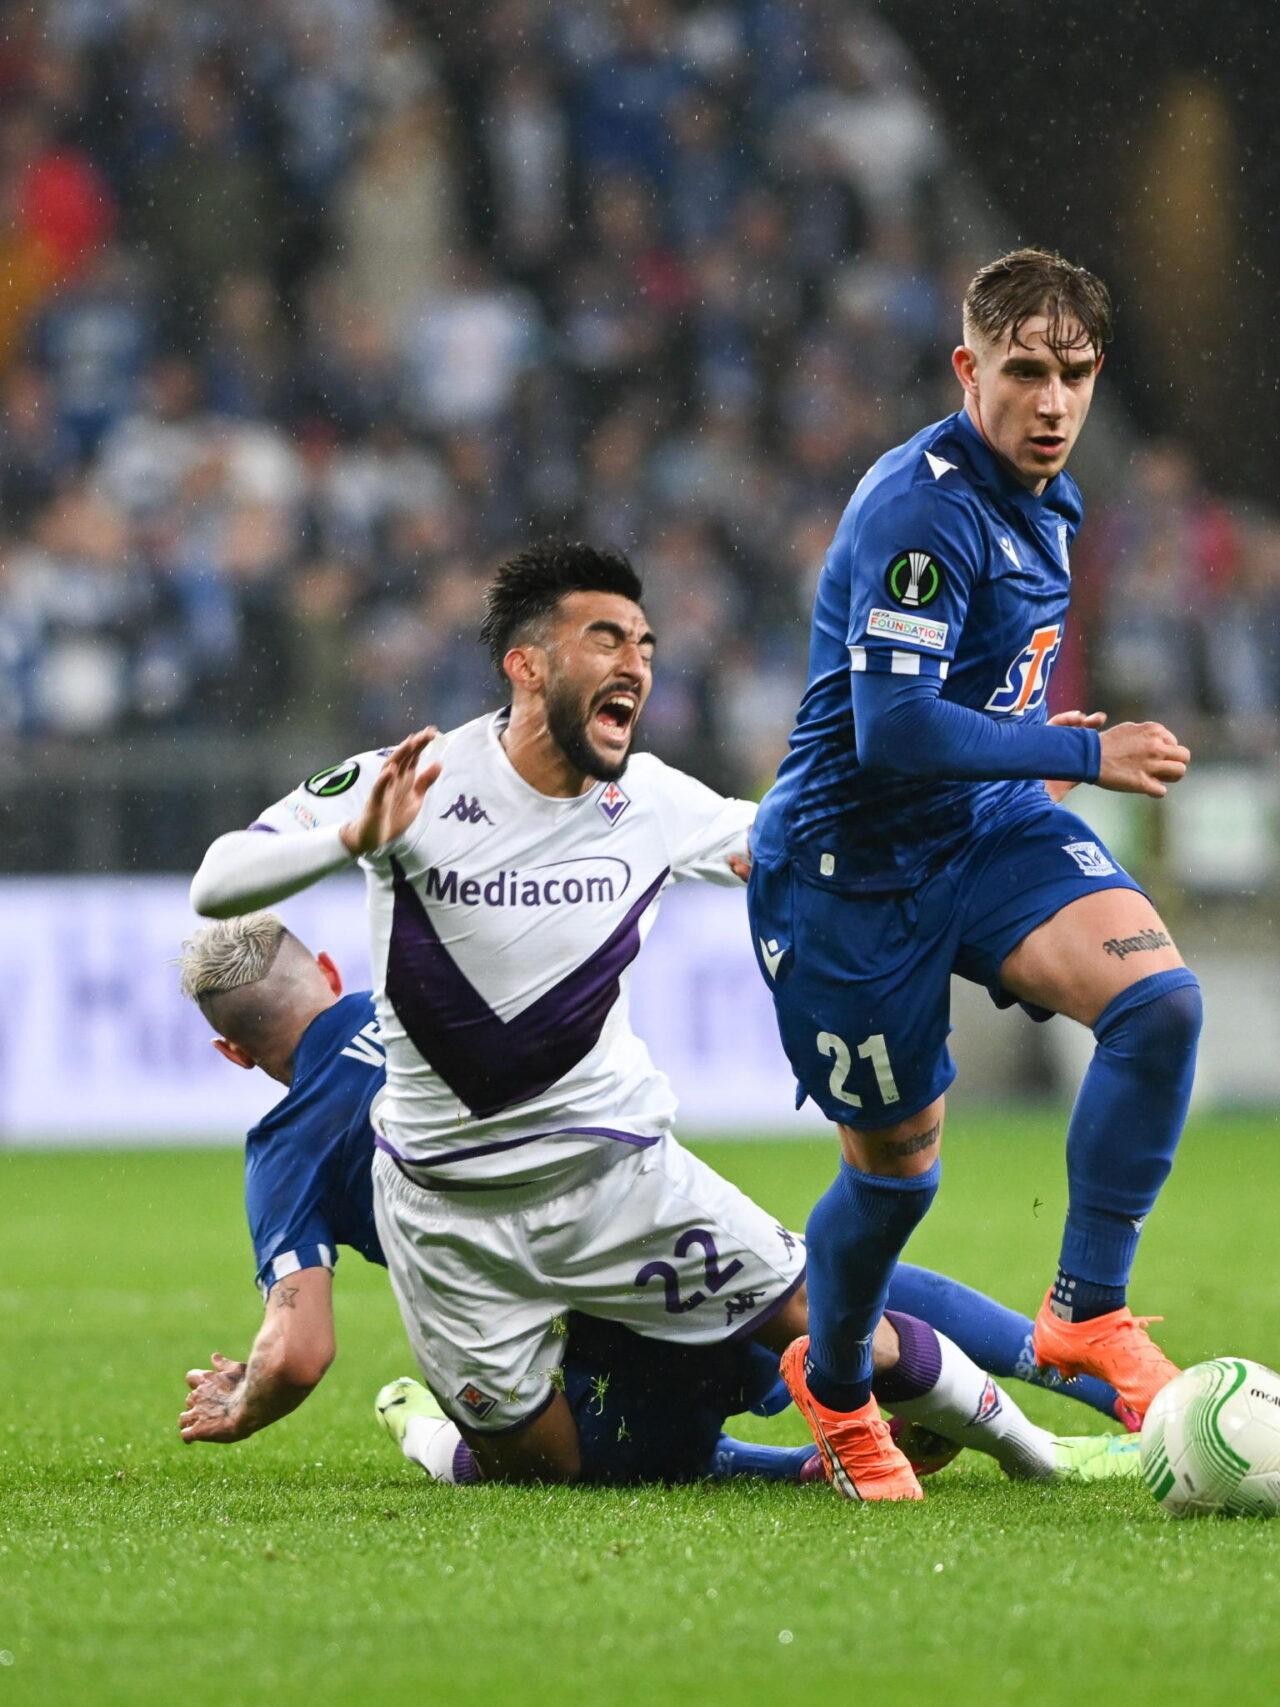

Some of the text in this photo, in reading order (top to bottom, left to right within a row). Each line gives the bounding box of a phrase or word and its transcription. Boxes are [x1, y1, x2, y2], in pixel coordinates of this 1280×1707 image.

[870, 617, 945, 640] FOUNDATION
[984, 624, 1061, 715] STS
[426, 867, 615, 907] Mediacom
[816, 1031, 901, 1109] 21
[634, 1228, 745, 1314] 22
